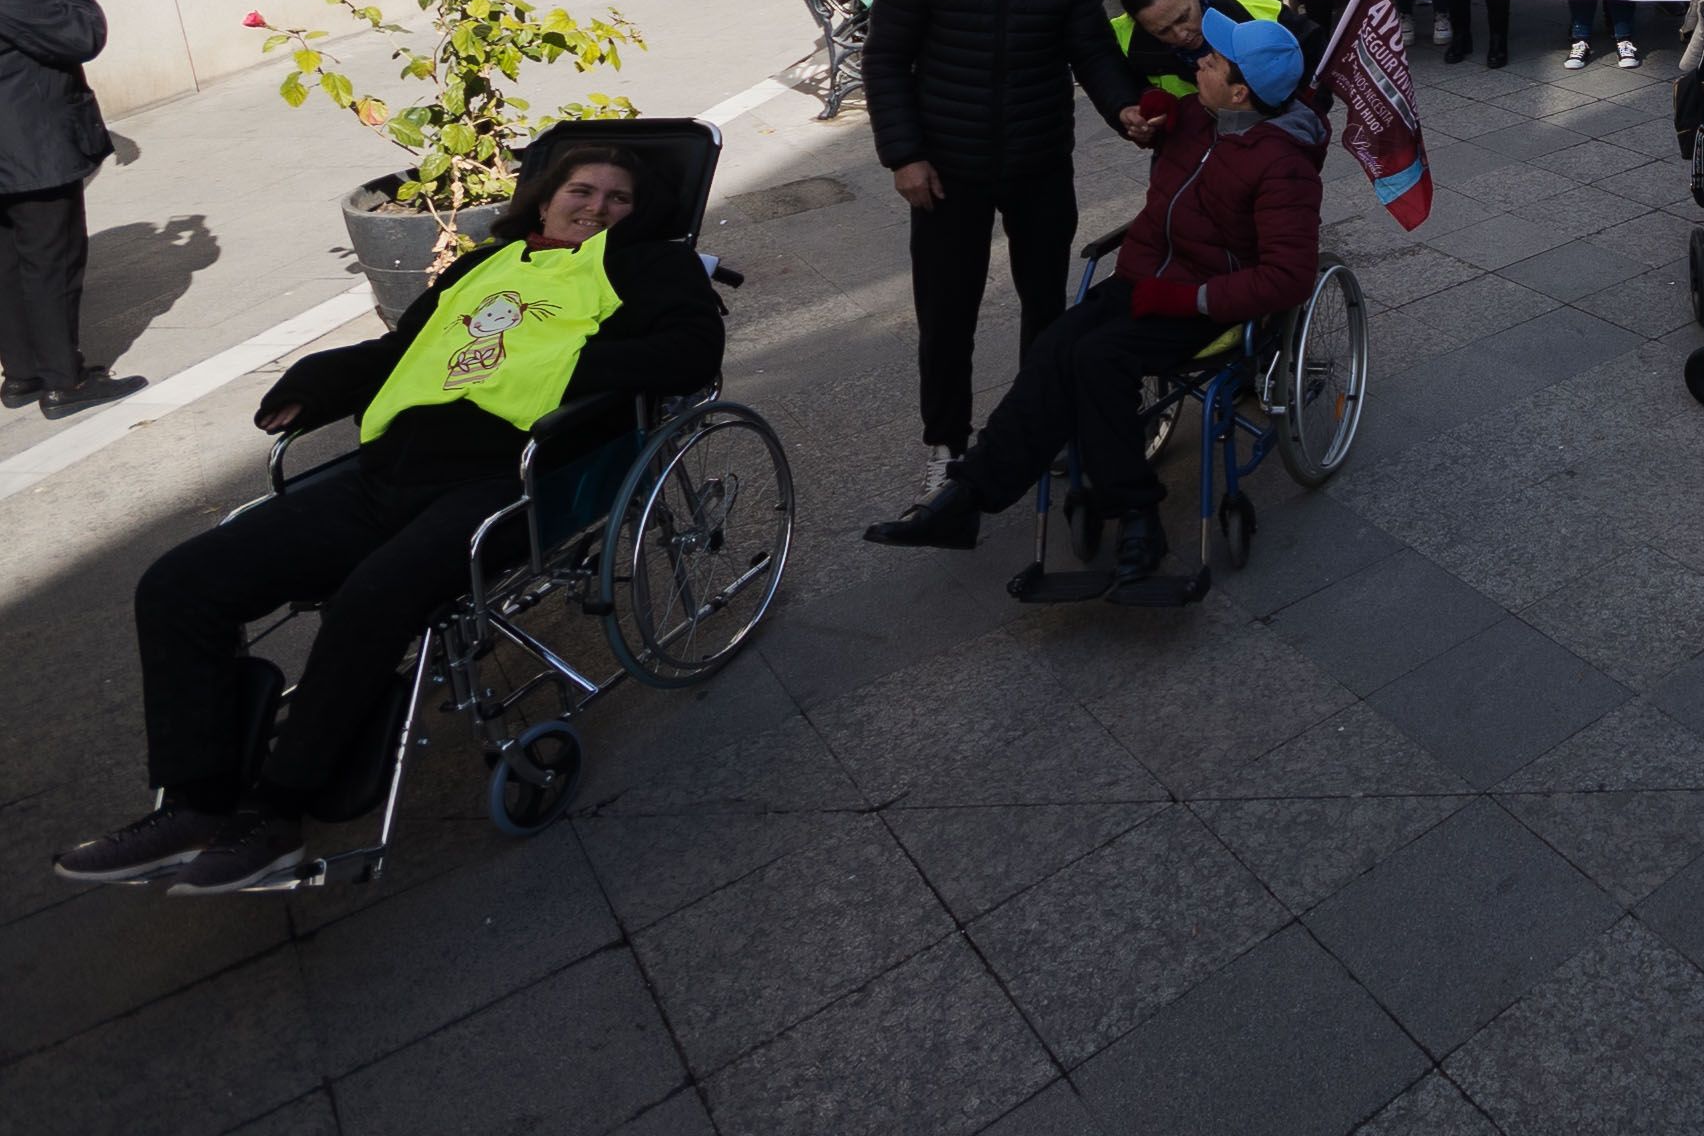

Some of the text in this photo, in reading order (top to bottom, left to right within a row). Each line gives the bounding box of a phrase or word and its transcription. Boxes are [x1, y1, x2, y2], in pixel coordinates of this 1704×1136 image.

[1363, 27, 1397, 74] SEGUIR
[1352, 93, 1365, 110] TU
[1360, 106, 1385, 136] HIJO?
[1364, 88, 1394, 129] NECESITA,
